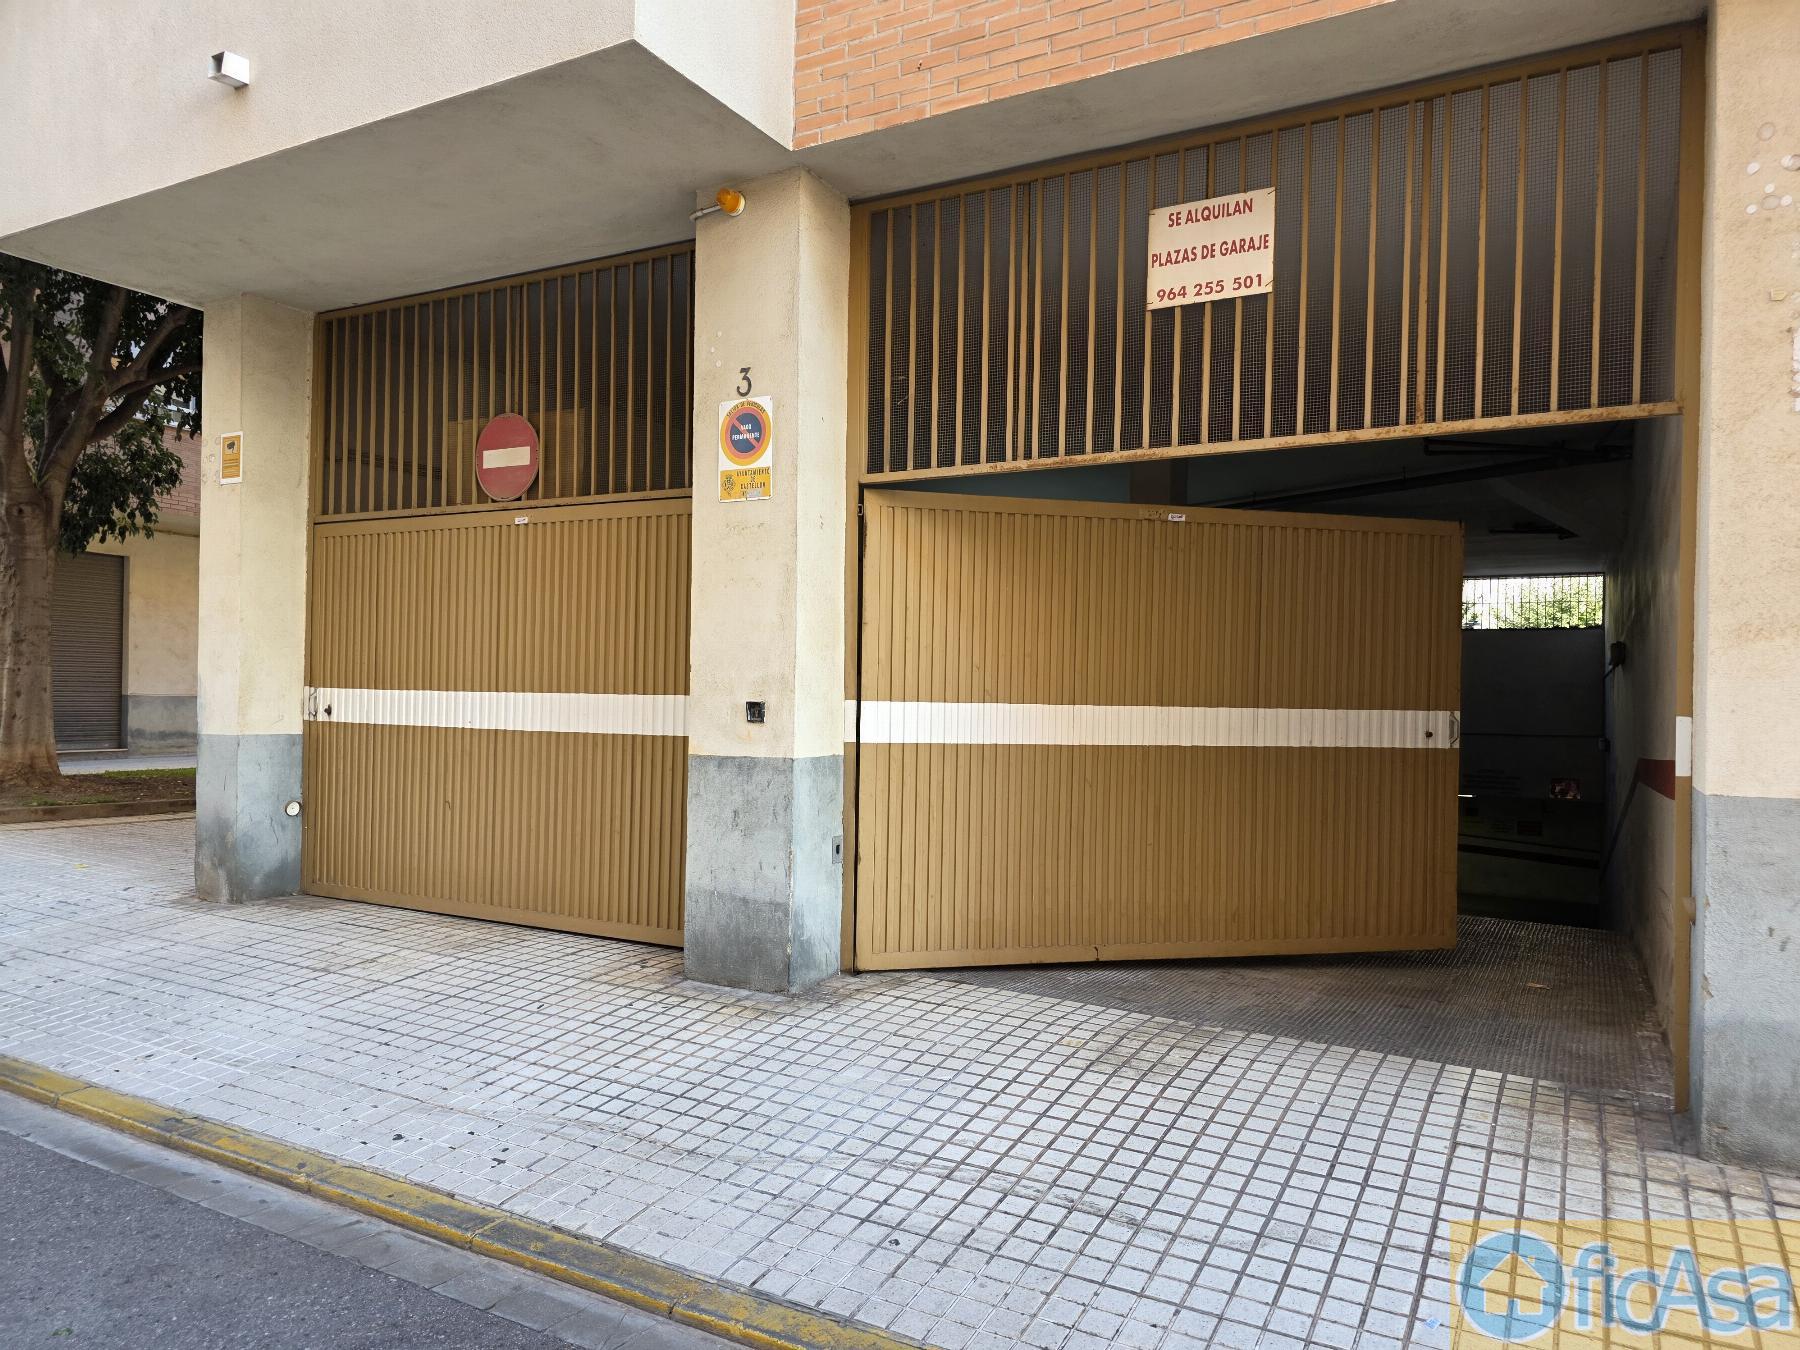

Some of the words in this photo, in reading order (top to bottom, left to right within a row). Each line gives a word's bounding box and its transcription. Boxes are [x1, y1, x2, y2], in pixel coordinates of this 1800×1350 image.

[1168, 211, 1182, 227] SE
[1185, 198, 1253, 225] ALQUILAN
[1151, 246, 1197, 268] PLAZAS
[1201, 243, 1216, 259] DE
[1220, 234, 1269, 256] GARAJE
[1157, 286, 1187, 302] 964
[1193, 280, 1224, 297] 255
[1232, 273, 1262, 291] 501
[736, 366, 752, 397] 3
